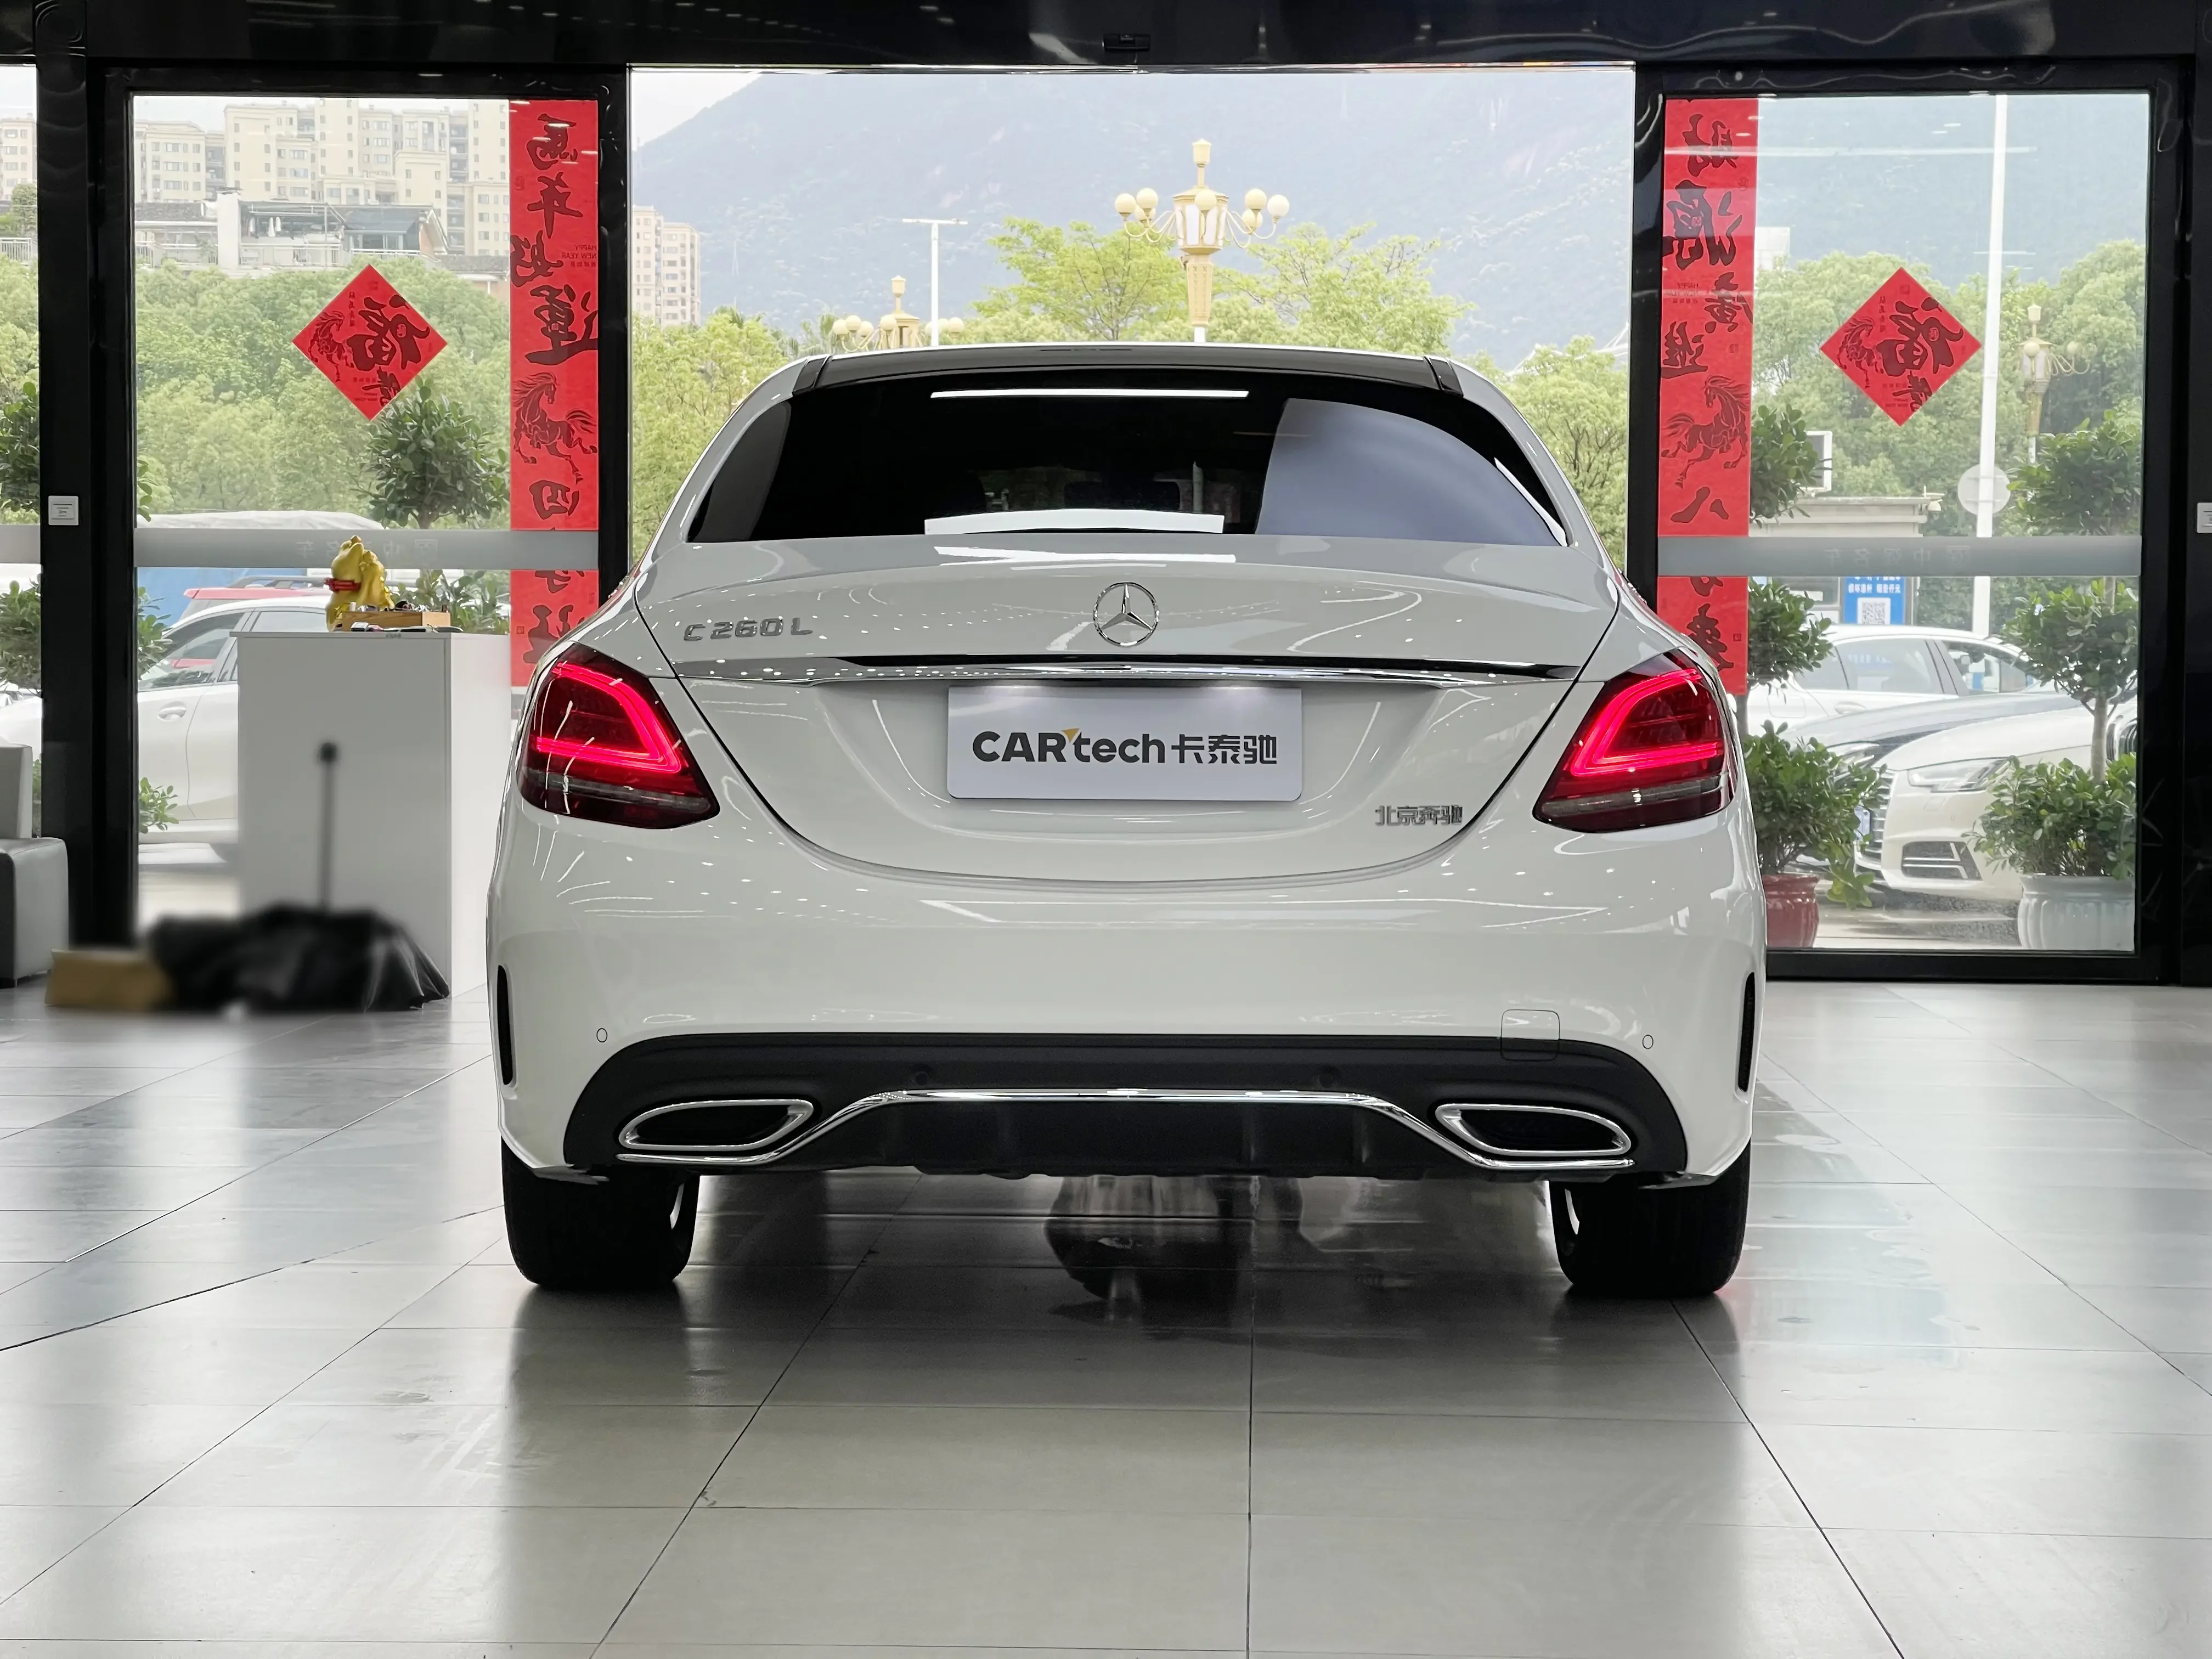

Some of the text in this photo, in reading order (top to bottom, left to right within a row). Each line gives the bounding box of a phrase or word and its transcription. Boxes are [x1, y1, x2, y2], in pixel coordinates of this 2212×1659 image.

[972, 730, 1277, 765] CARtech 卡泰驰
